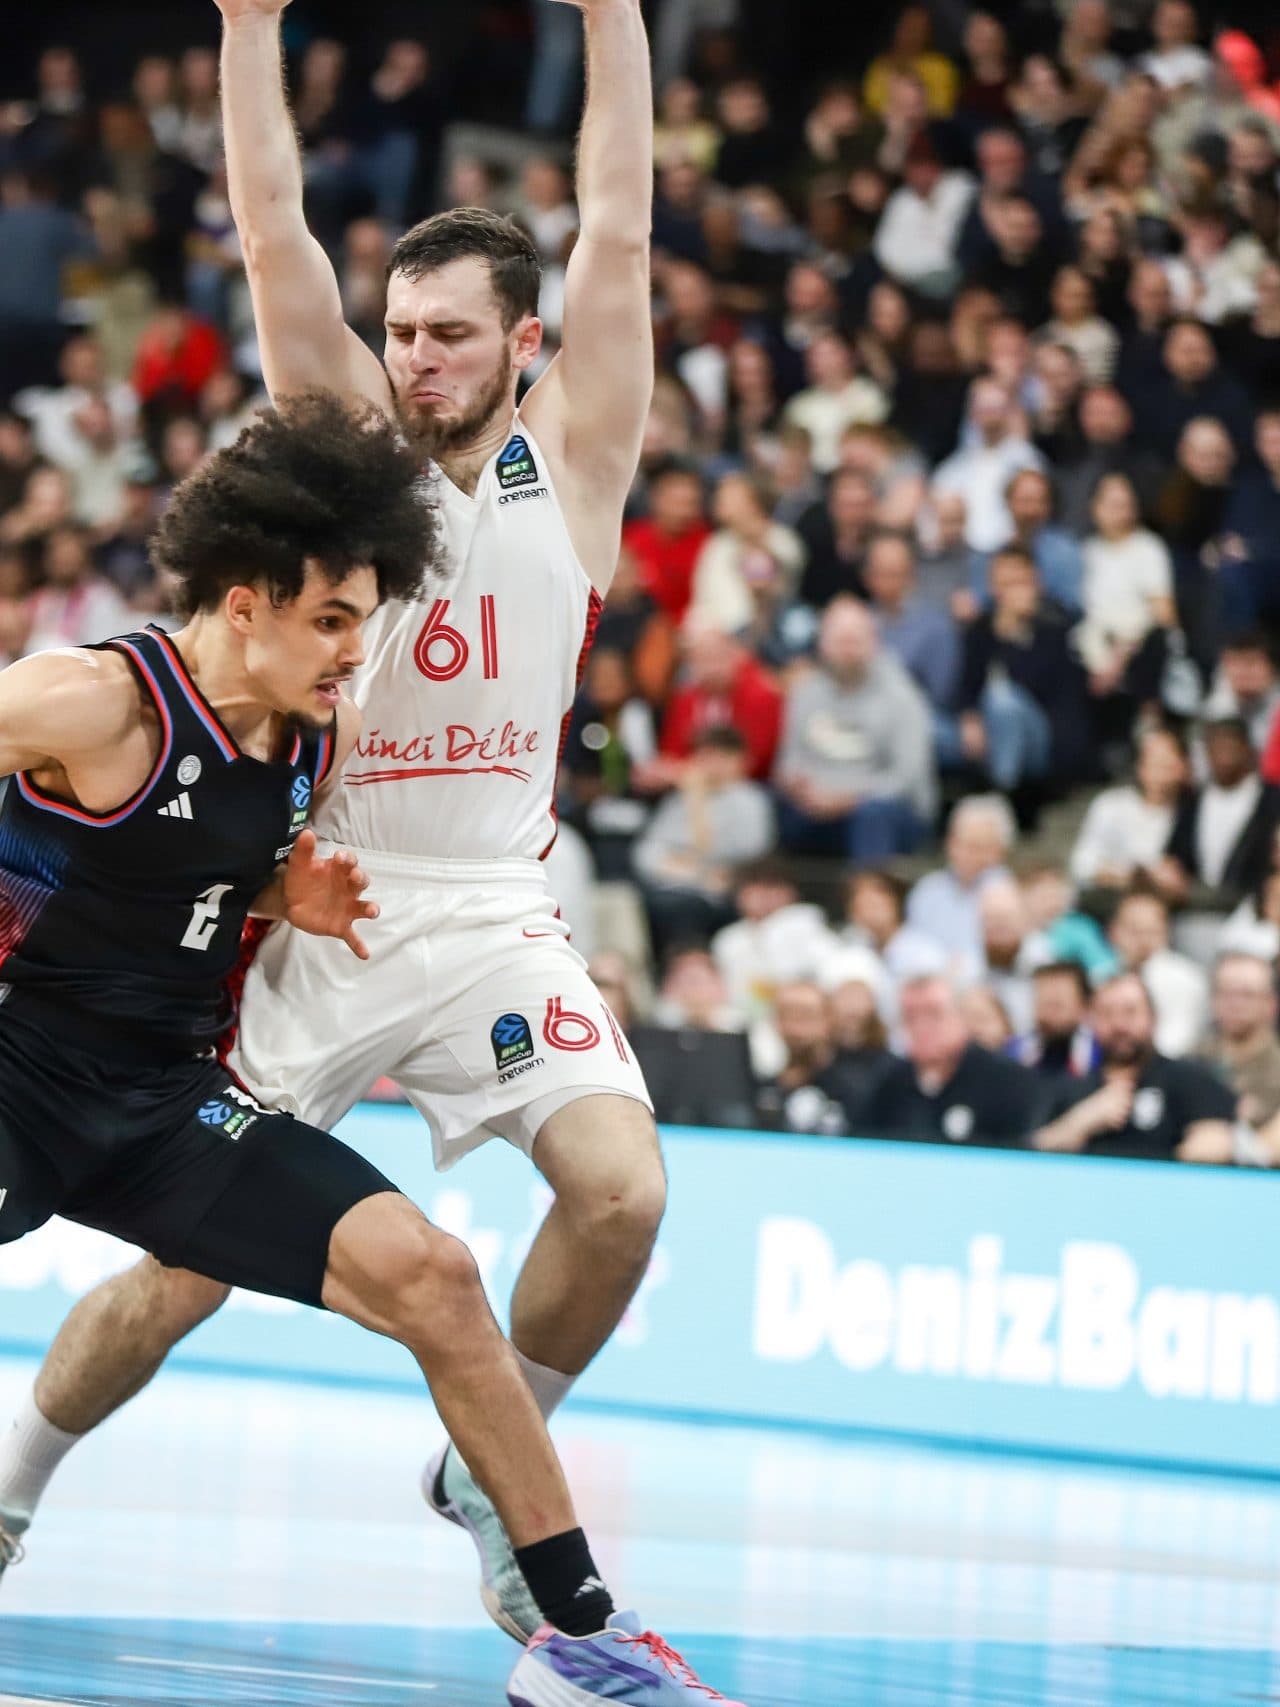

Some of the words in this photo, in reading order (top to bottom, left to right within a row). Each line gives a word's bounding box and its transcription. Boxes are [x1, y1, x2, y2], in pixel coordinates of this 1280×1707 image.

[502, 472, 536, 485] EuroCup
[413, 594, 499, 682] 61
[179, 883, 235, 952] 2
[498, 1049, 533, 1067] EuroCup
[542, 995, 630, 1064] 61
